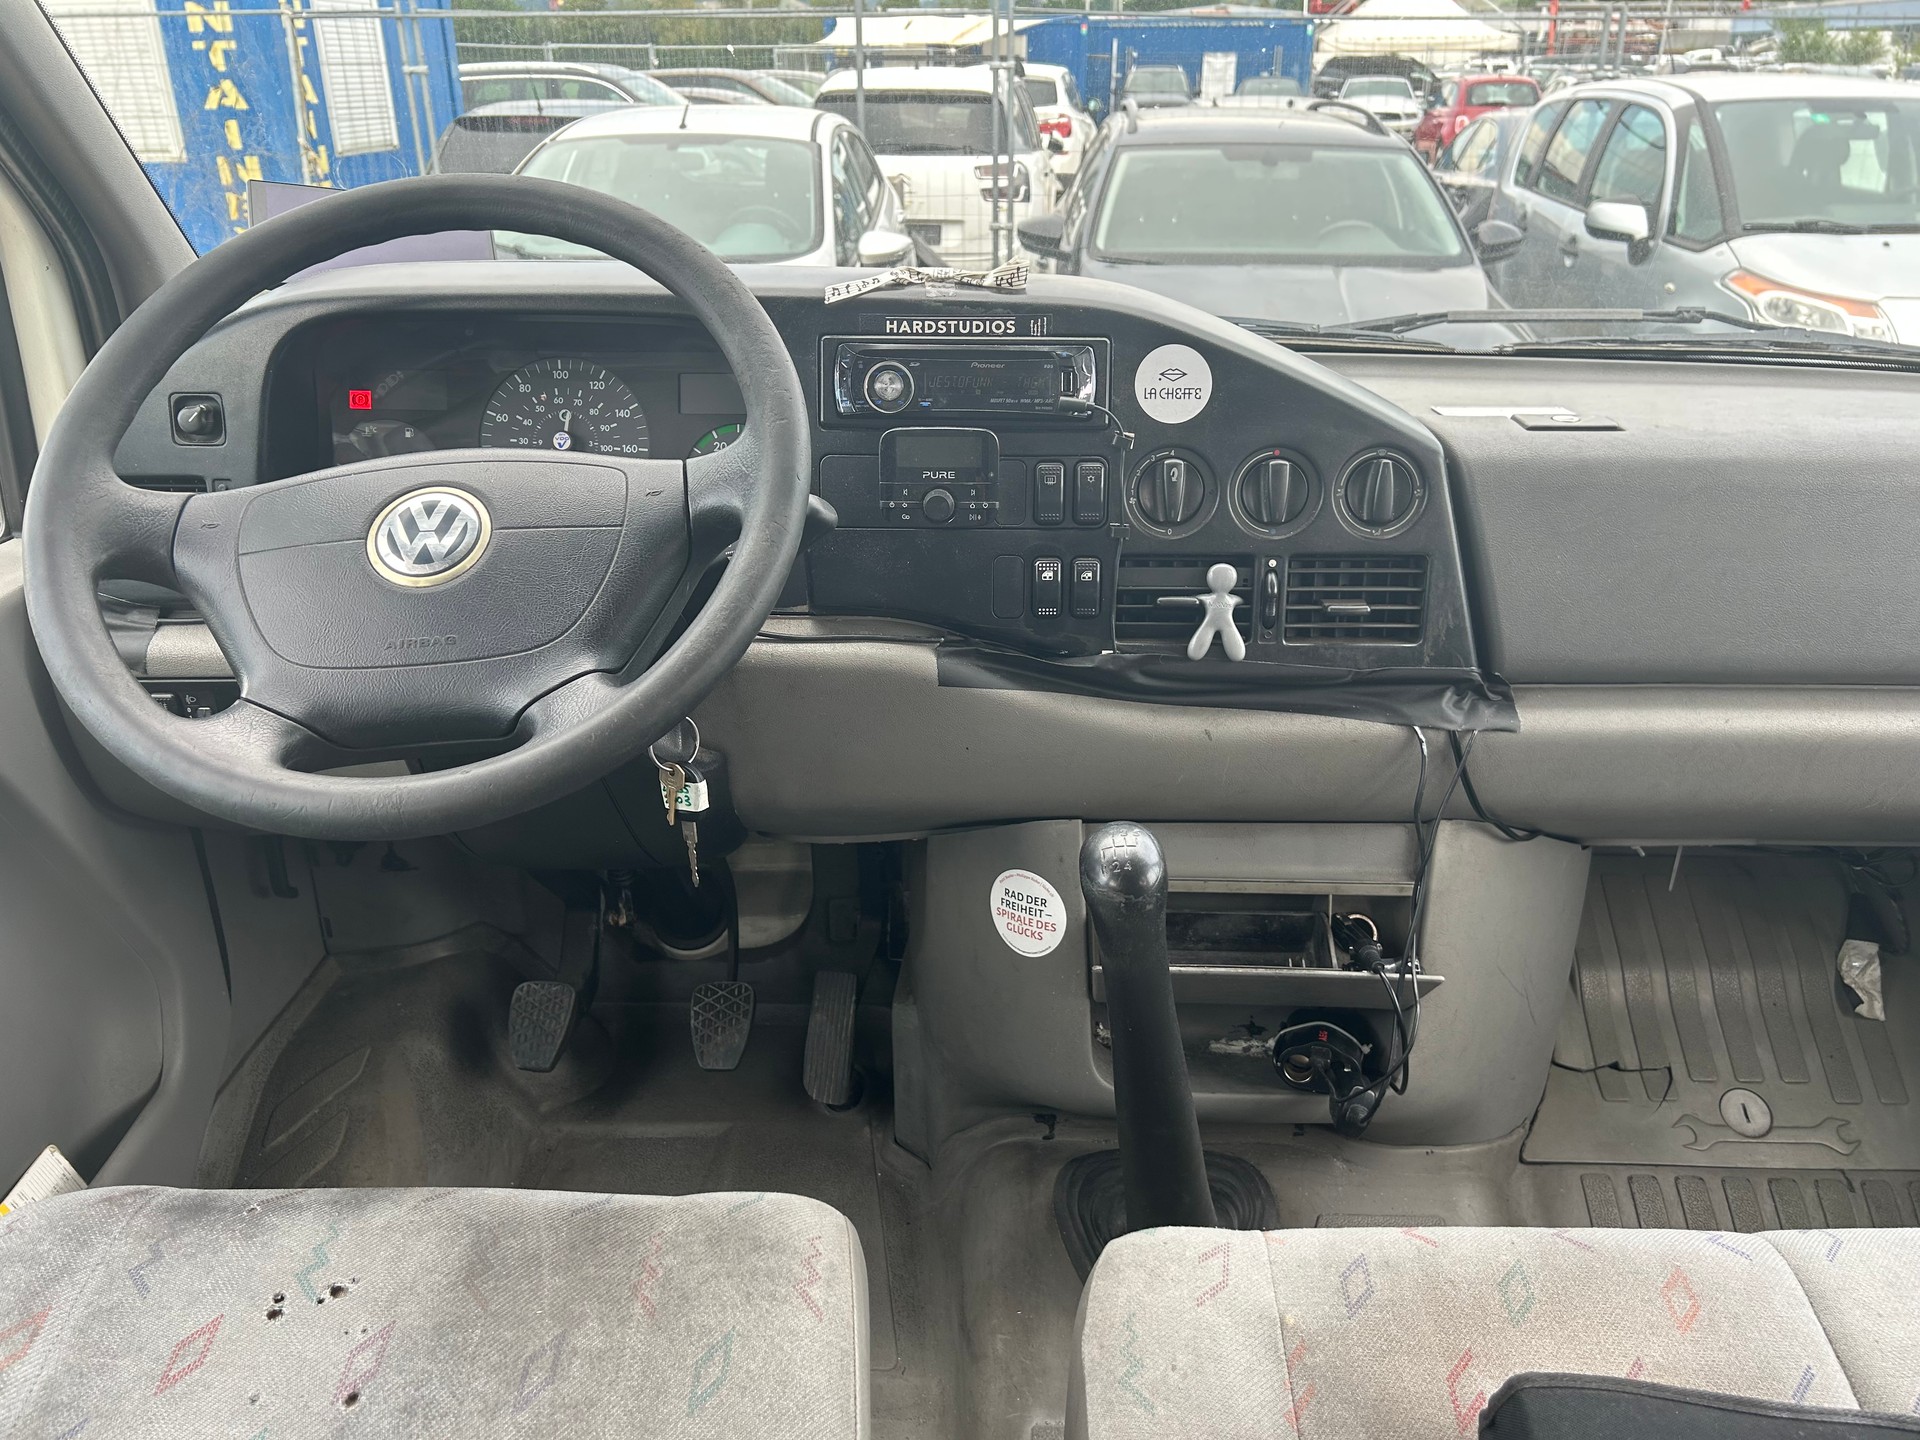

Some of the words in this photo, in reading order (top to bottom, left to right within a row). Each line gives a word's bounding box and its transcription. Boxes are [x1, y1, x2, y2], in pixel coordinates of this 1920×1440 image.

[886, 320, 1016, 334] HARDSTUDIOS
[970, 361, 1006, 369] Pioneer
[553, 371, 568, 379] 100
[519, 384, 531, 392] 80
[590, 382, 605, 390] 120
[1144, 387, 1157, 400] LA
[1159, 387, 1202, 400] CHEFFE
[590, 408, 599, 416] 80
[615, 410, 630, 418] 140
[496, 414, 508, 422] 60
[622, 445, 638, 453] 160
[922, 471, 956, 479] PURE
[384, 634, 458, 651] AIRBAG
[1112, 862, 1121, 873] 2
[1124, 861, 1132, 871] 4
[1004, 888, 1024, 902] RAD
[1026, 894, 1048, 908] DER
[1000, 898, 1044, 918] FREIHEIT
[996, 907, 1034, 928] SPIRALE
[1036, 920, 1056, 932] DES
[1006, 921, 1044, 941] GLÜCKS
